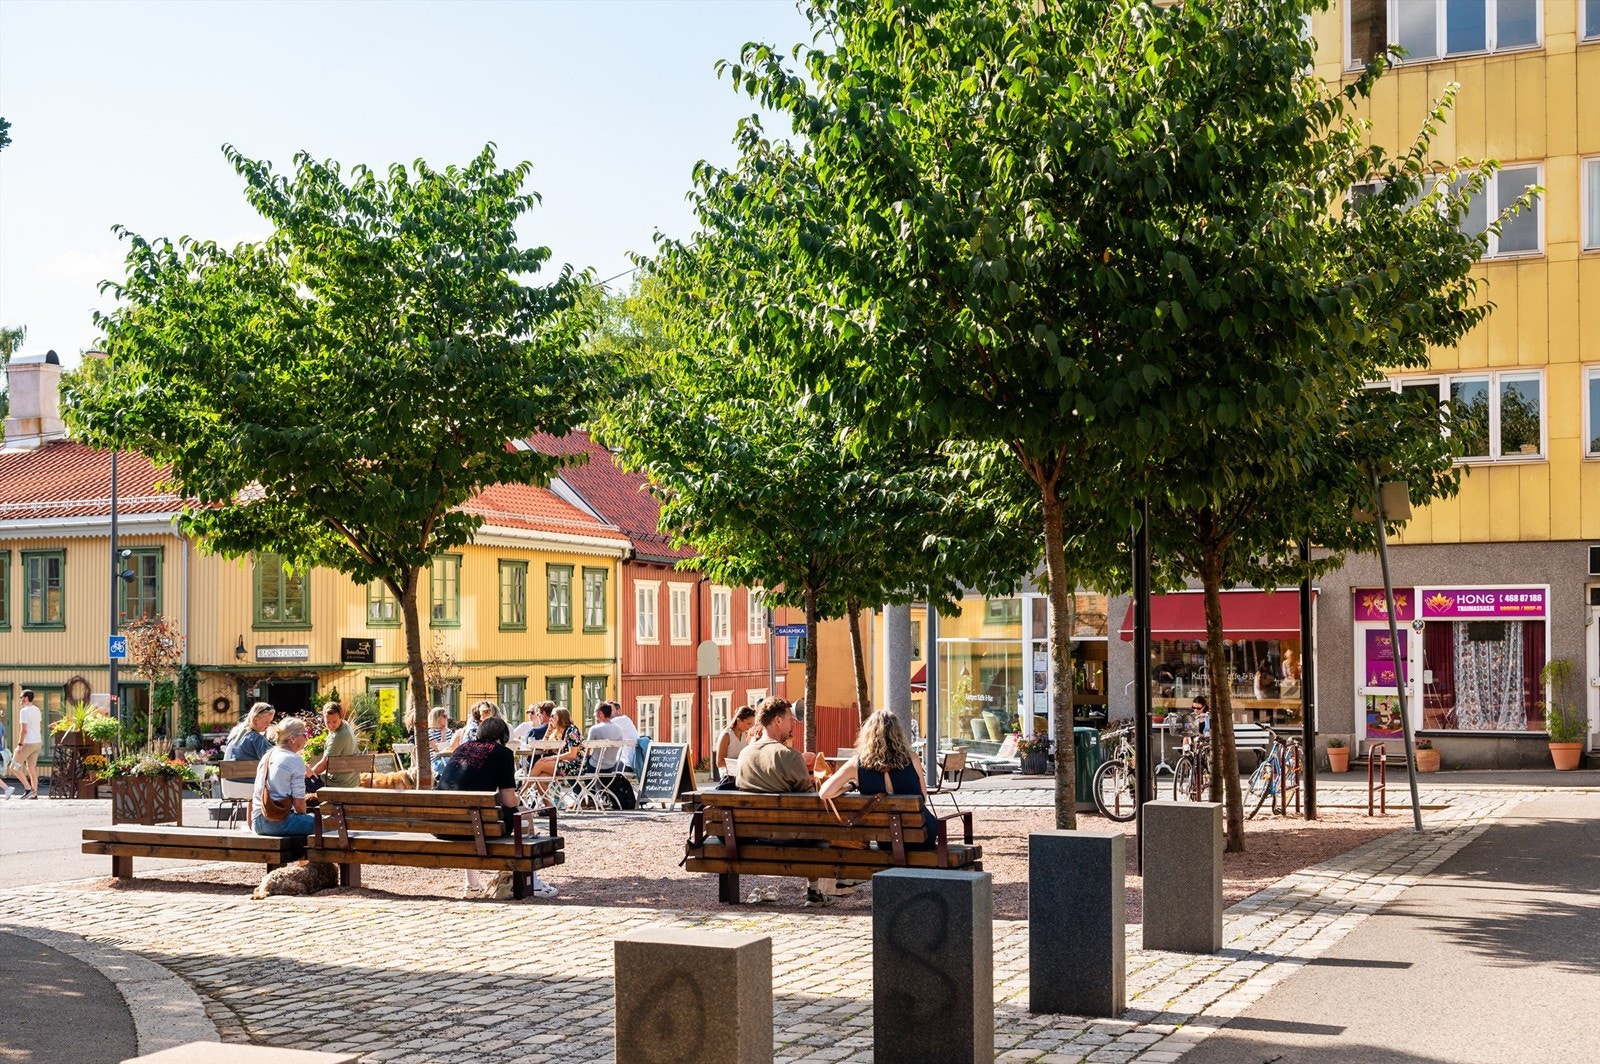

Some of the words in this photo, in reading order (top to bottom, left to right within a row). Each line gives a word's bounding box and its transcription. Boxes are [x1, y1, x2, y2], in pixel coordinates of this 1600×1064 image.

[1456, 594, 1495, 604] HONG
[1504, 594, 1518, 602] 468
[1520, 594, 1528, 602] 87
[1529, 594, 1542, 602] 186
